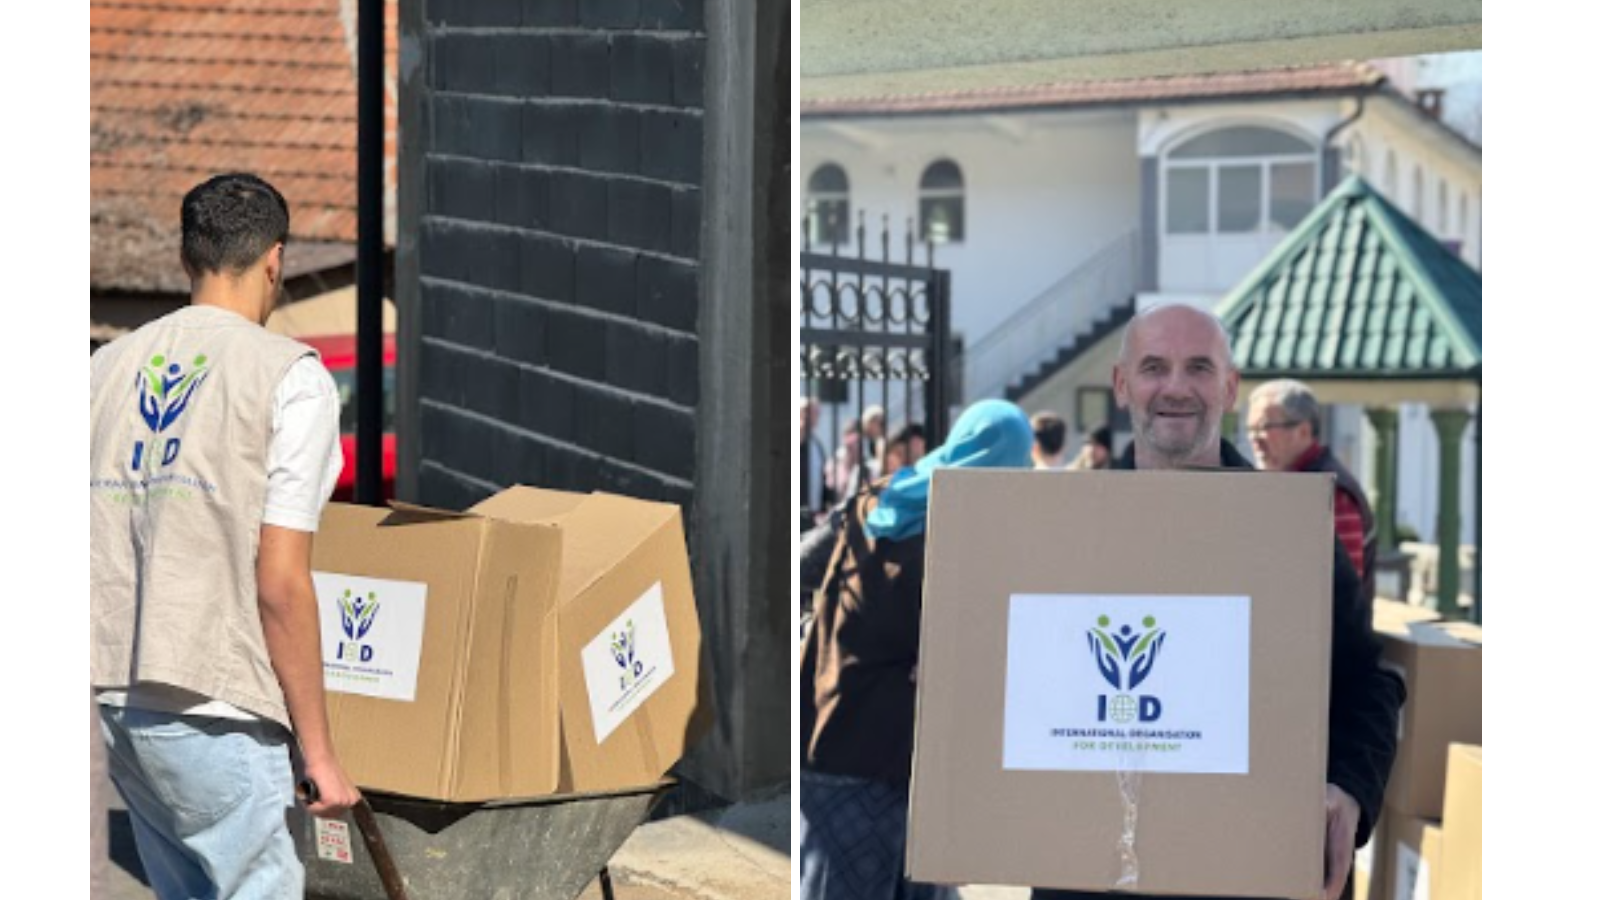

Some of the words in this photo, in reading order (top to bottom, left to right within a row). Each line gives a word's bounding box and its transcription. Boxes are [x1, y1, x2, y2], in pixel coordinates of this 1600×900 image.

[1051, 728, 1126, 738] INTERNATIONAL
[1129, 729, 1203, 740] ORGANISATION
[1073, 741, 1096, 751] FOR
[1100, 741, 1182, 752] DEVELOPMENT
